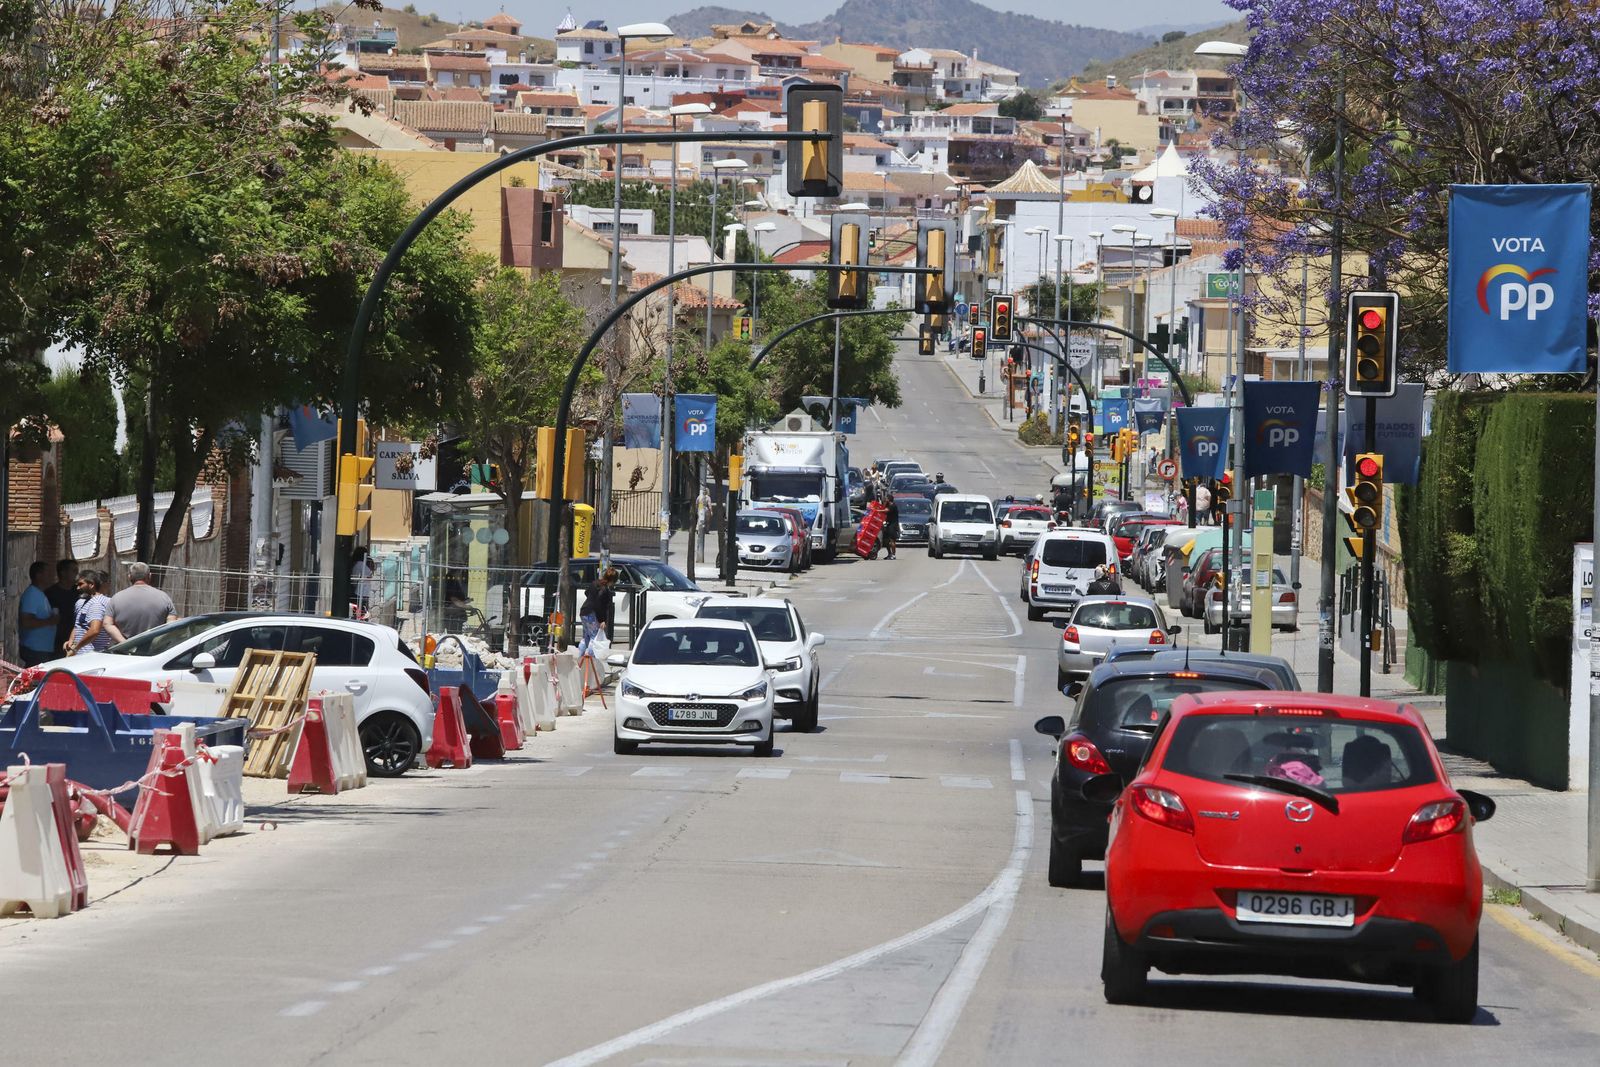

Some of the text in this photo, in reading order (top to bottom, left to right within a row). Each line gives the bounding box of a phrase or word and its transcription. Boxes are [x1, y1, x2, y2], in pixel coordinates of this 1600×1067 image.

[1492, 237, 1545, 253] VOTA
[1500, 282, 1555, 321] pp
[1266, 406, 1295, 415] VOTA
[841, 416, 852, 425] pp
[1111, 415, 1122, 424] pp
[690, 423, 707, 436] pp
[1269, 428, 1300, 448] pp
[1198, 441, 1219, 457] pp
[391, 472, 420, 481] SALVA
[674, 710, 715, 719] 4789 JNL
[1250, 895, 1349, 918] 0296 GBJ
